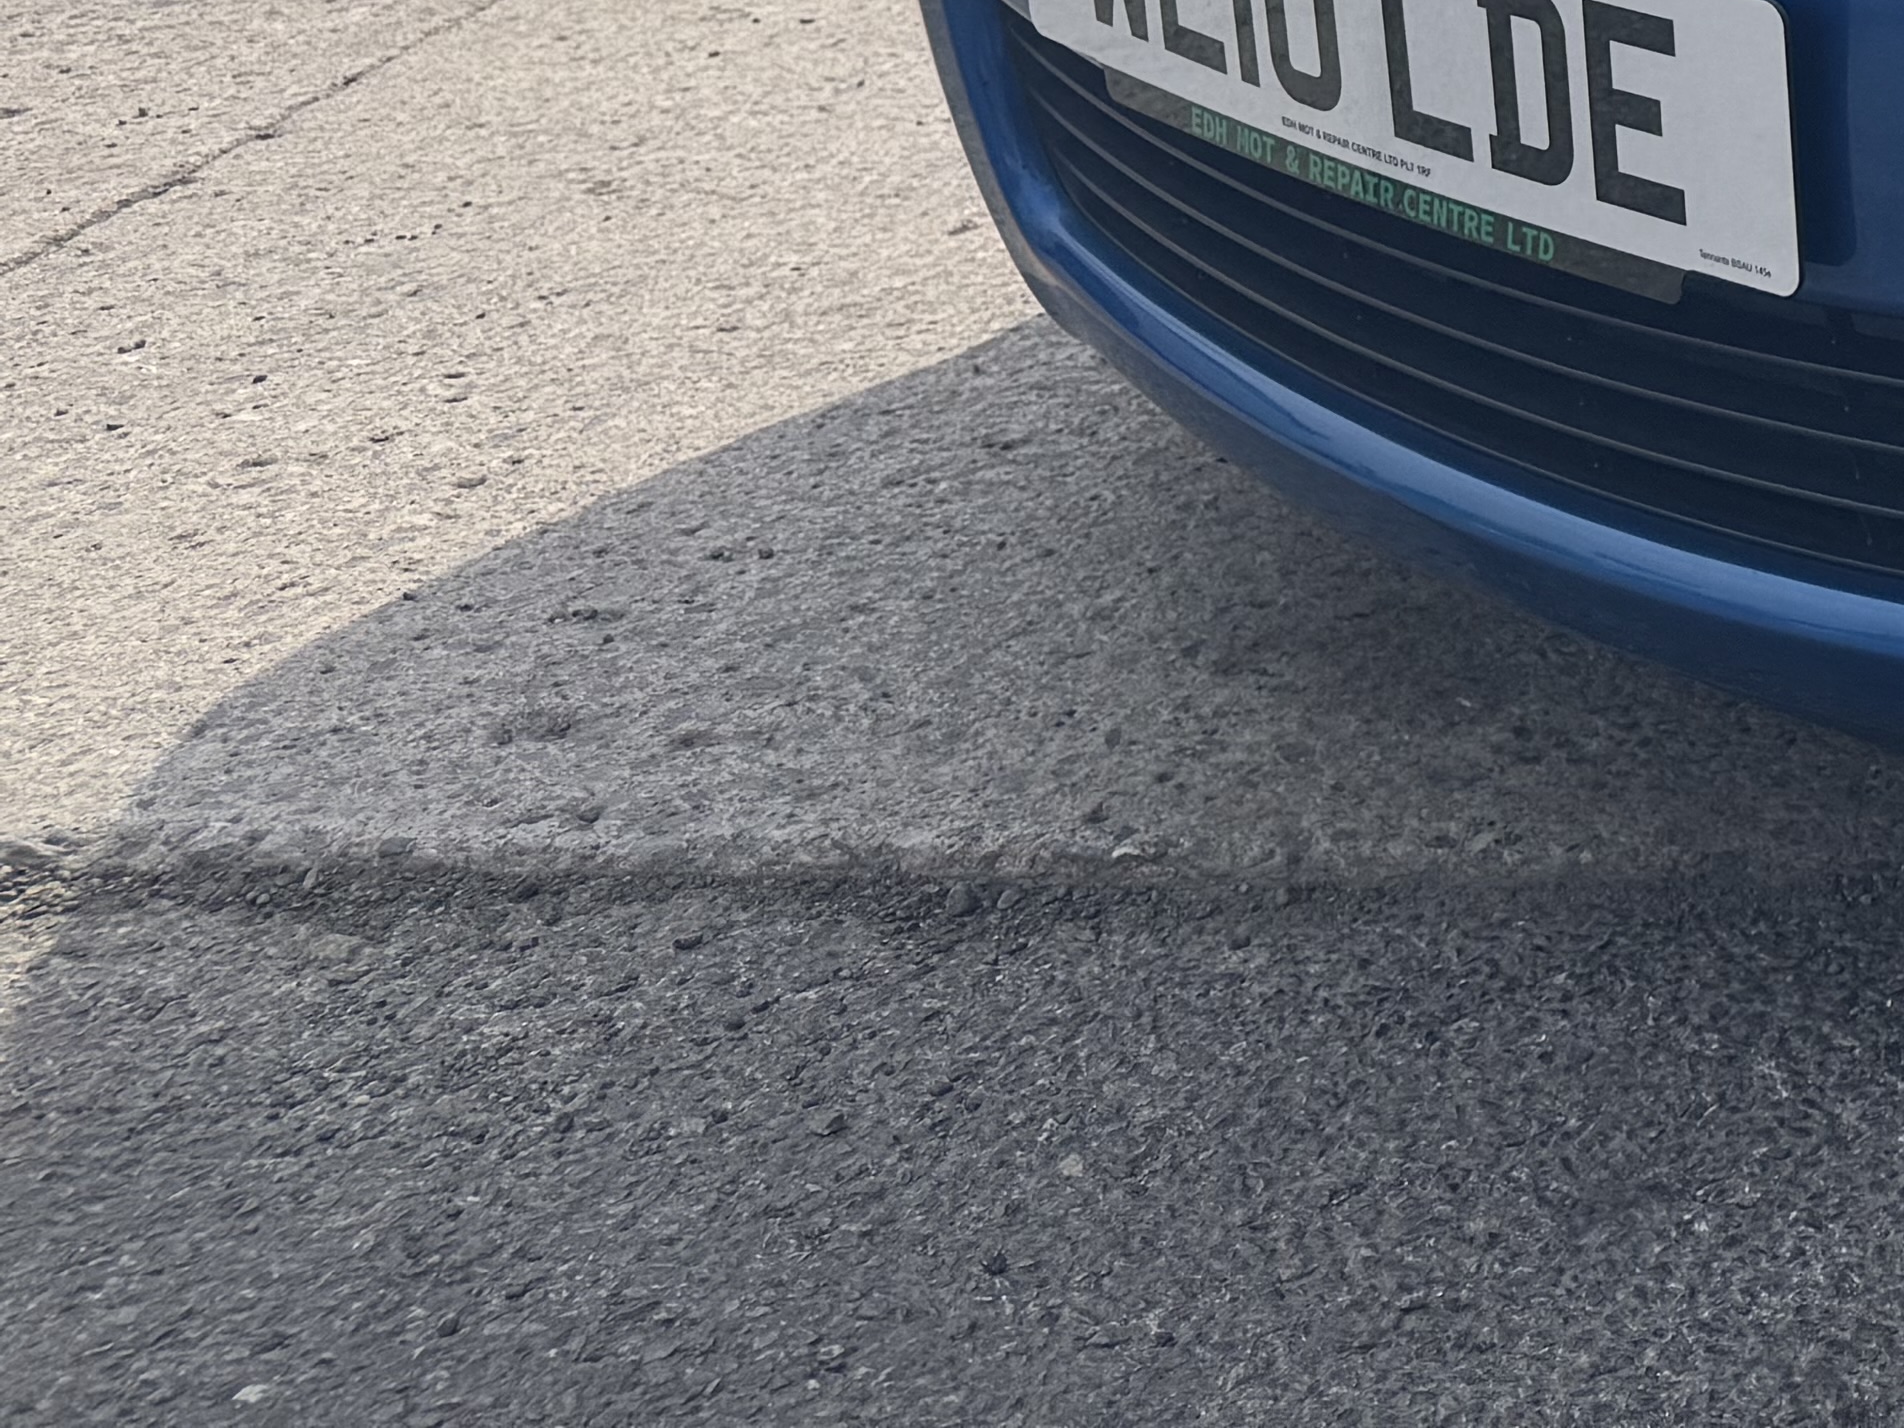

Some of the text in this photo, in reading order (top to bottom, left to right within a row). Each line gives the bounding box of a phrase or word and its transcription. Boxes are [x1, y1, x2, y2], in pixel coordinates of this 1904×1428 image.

[1191, 105, 1554, 262] EDH MOT & REPAIR CENTRE LTD
[1323, 131, 1350, 148] REPAIR
[1351, 142, 1382, 162] CENTRE
[1384, 153, 1399, 168] LTD
